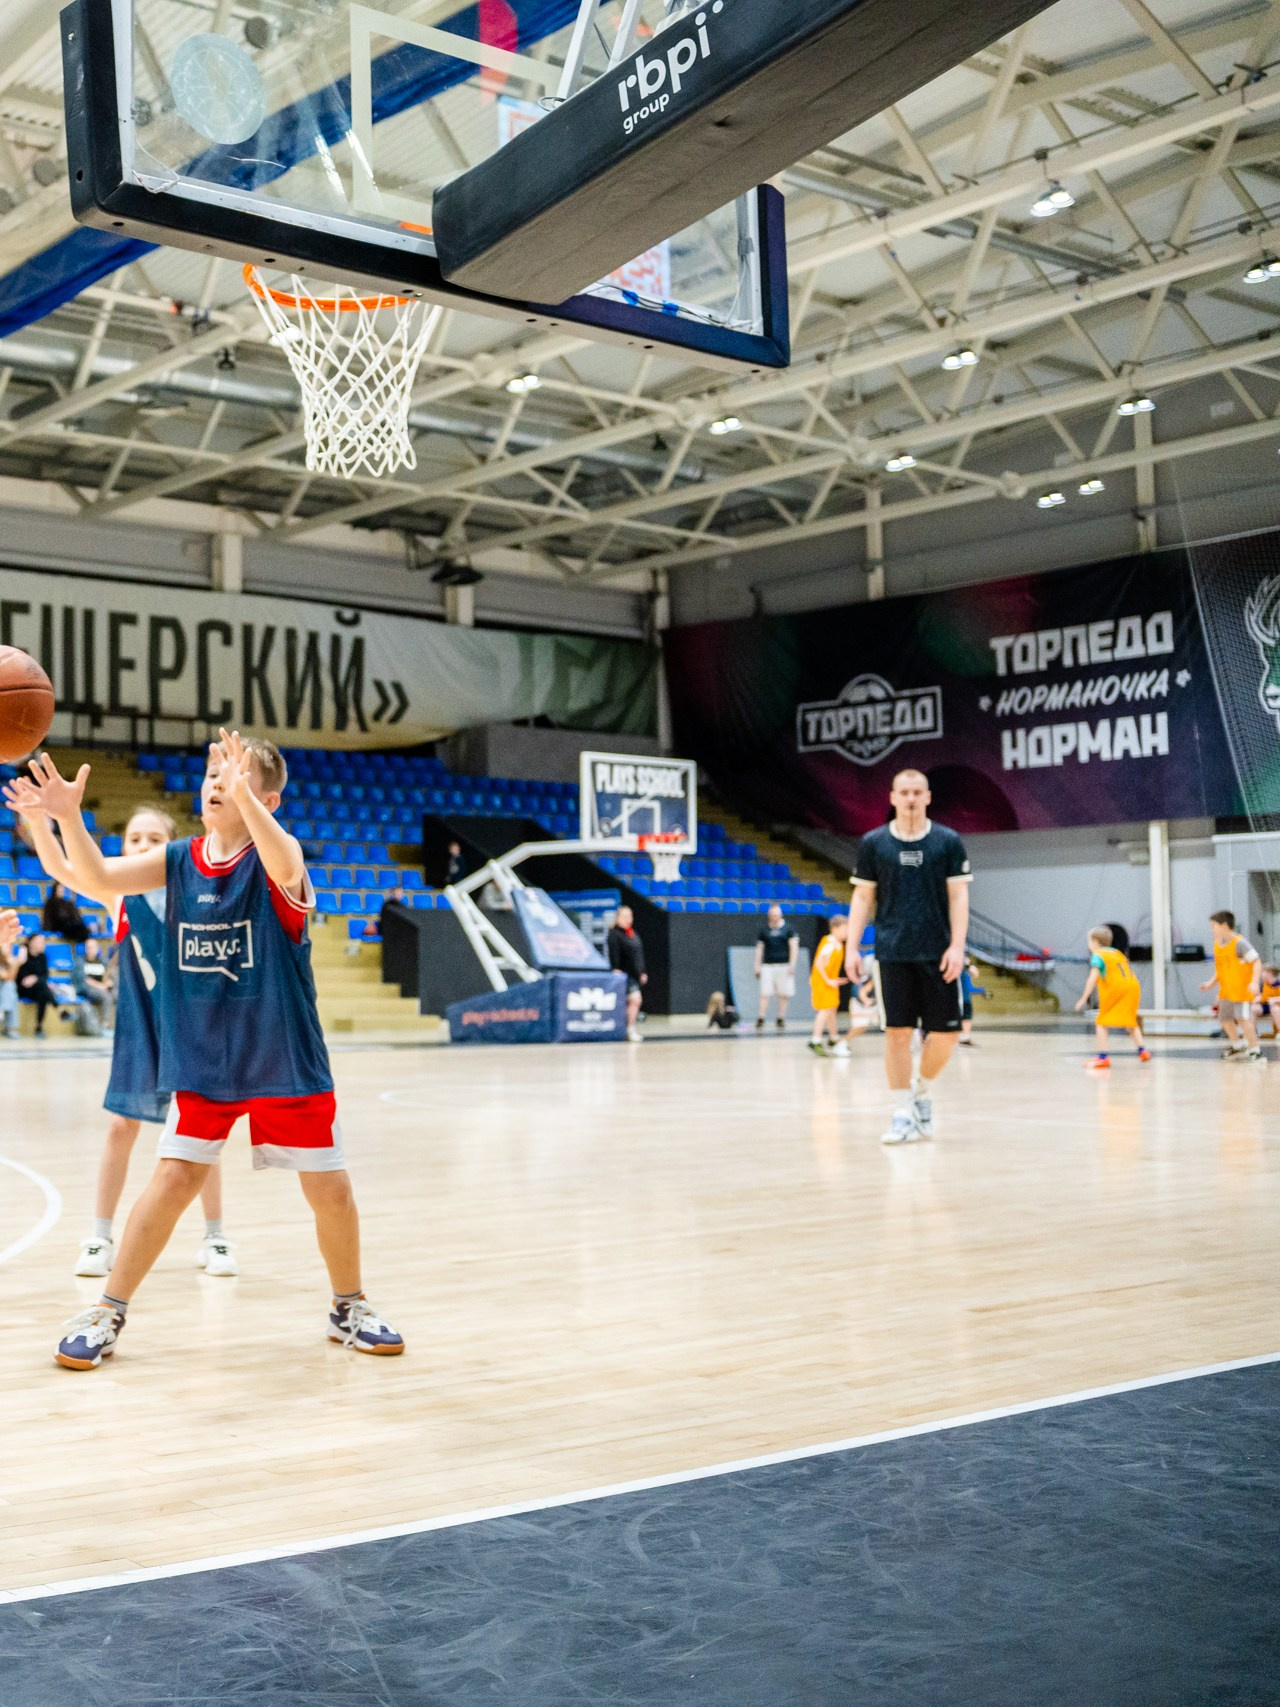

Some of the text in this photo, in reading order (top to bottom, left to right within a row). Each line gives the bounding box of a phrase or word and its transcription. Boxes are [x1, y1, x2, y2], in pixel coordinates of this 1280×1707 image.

[623, 93, 670, 134] group
[989, 611, 1175, 676] ТОРПЕДО
[996, 668, 1170, 718] НОРМАНОЧКА
[805, 696, 934, 742] ТОРПЕДО
[1001, 712, 1170, 770] НОРМАН
[595, 763, 685, 798] PLAYS SCHOOL
